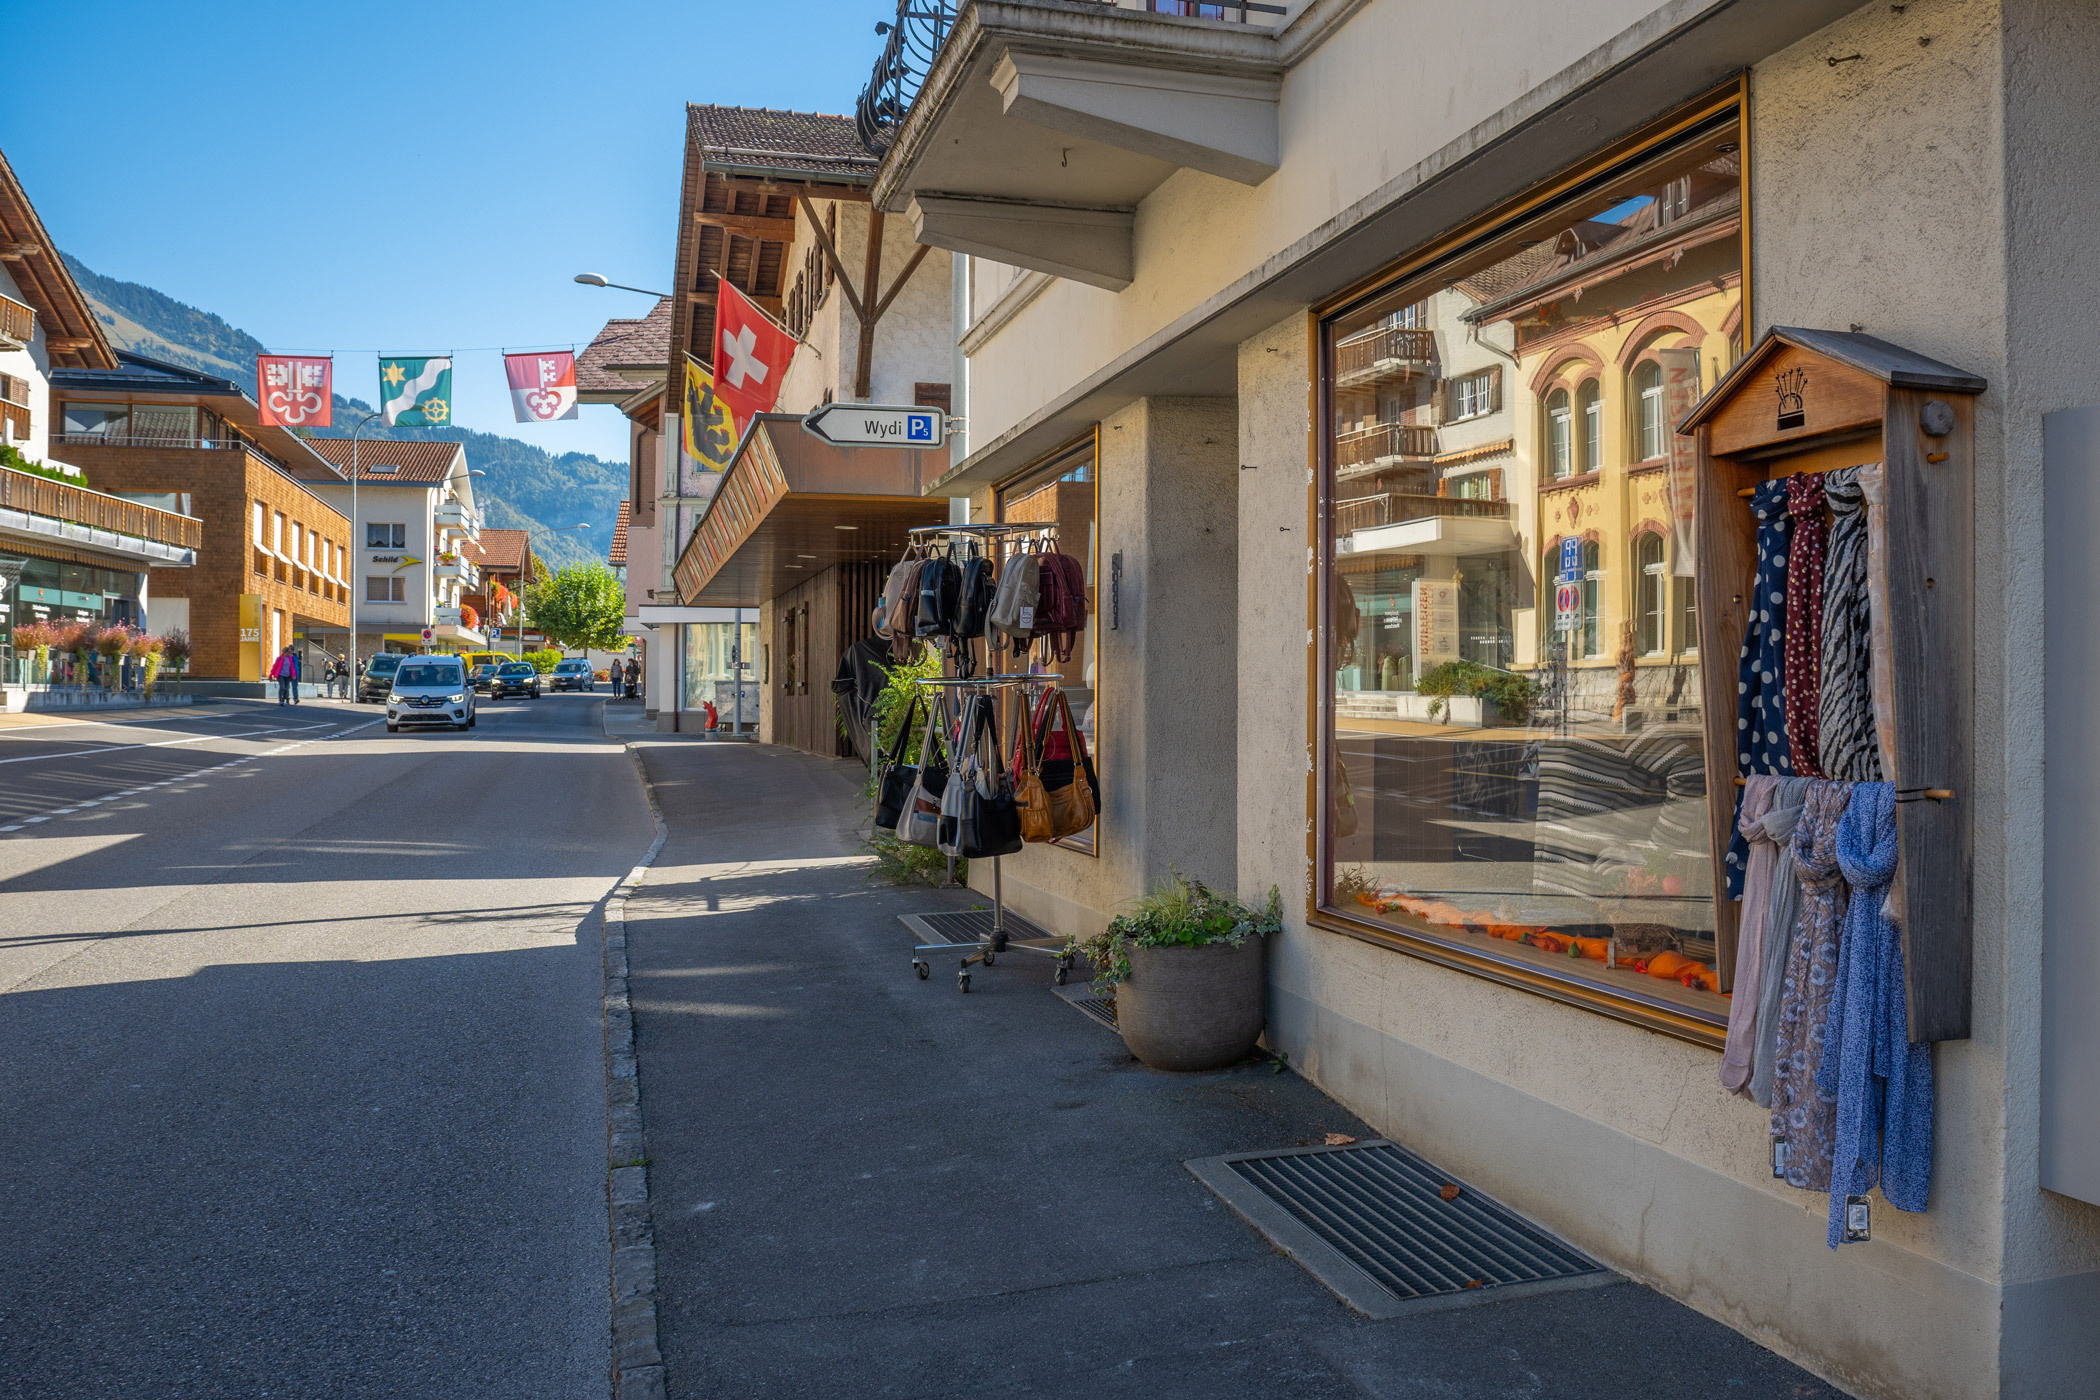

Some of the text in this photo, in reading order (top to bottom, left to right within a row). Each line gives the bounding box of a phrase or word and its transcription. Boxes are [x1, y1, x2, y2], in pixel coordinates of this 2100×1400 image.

[864, 420, 902, 438] Wydi
[372, 555, 399, 563] Schild
[240, 628, 260, 637] 175
